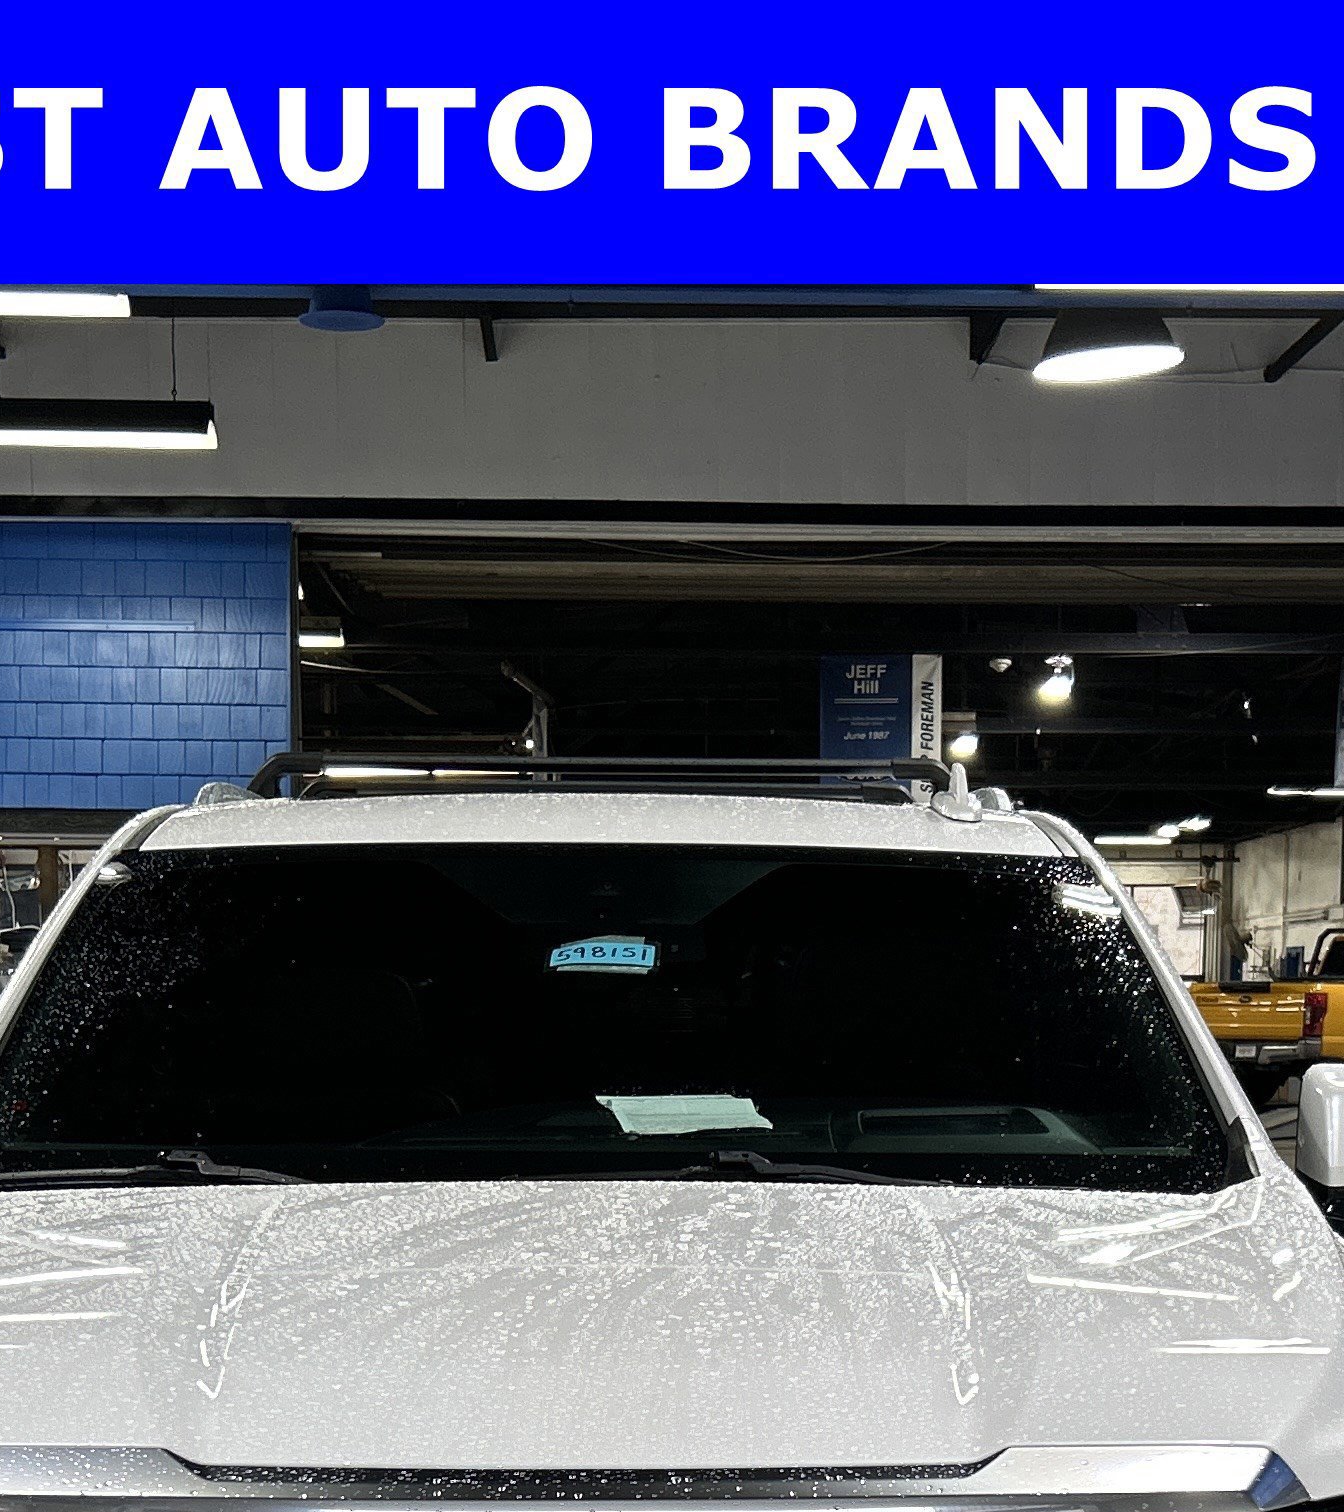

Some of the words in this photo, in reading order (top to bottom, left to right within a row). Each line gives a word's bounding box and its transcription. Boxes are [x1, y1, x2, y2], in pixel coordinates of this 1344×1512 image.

[846, 664, 887, 679] JEFF
[854, 680, 879, 694] Hill
[921, 681, 934, 750] FOREMAN
[844, 732, 866, 741] June
[557, 946, 650, 962] 598151
